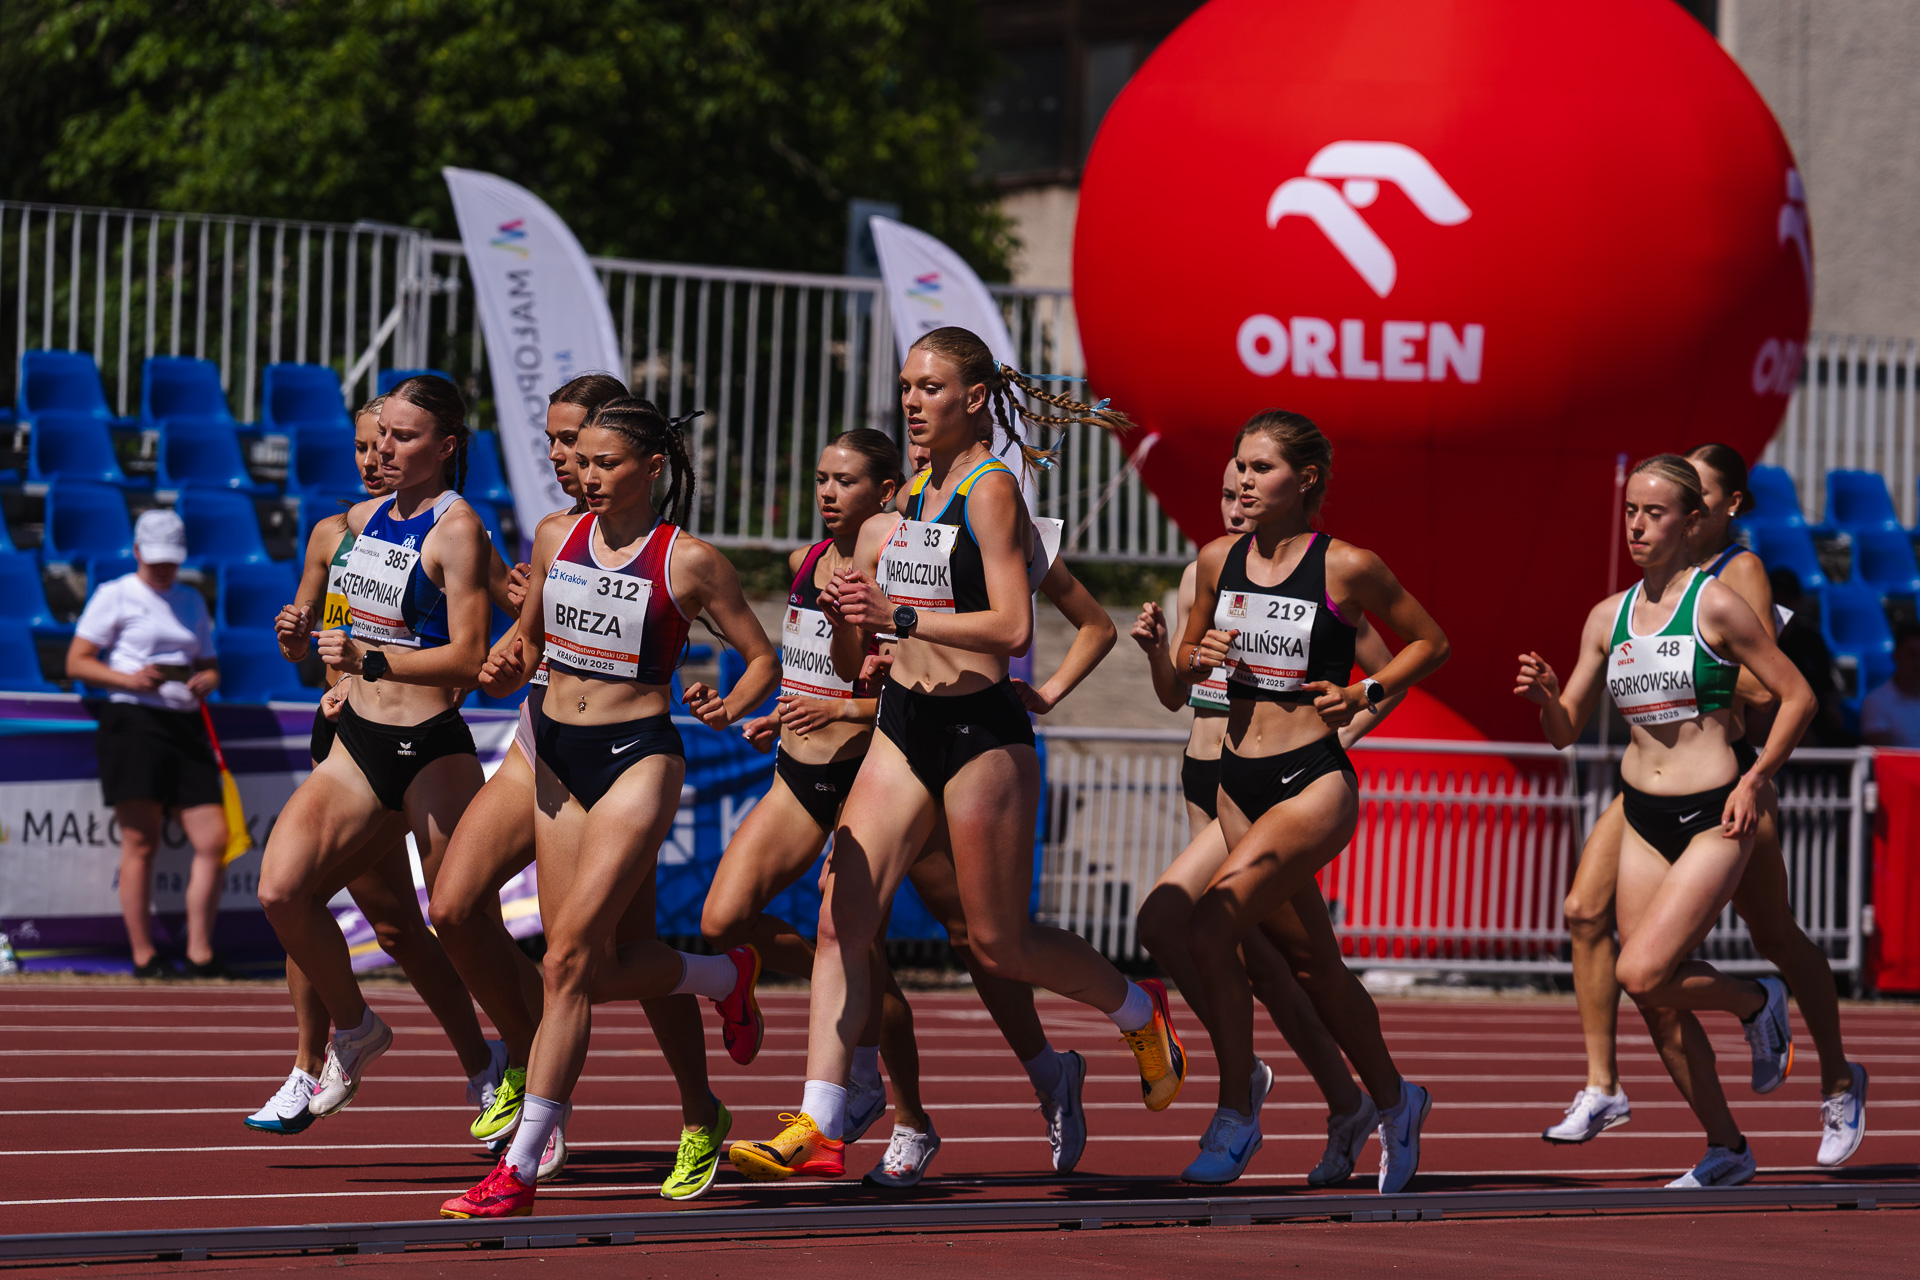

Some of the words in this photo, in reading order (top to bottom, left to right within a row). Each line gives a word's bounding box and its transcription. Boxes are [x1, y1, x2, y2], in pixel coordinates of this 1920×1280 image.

[1236, 313, 1485, 384] ORLEN
[924, 528, 942, 548] 33
[384, 548, 410, 571] 385
[559, 571, 588, 587] Kraków
[596, 576, 640, 602] 312
[343, 571, 403, 609] STEMPNIAK
[555, 602, 622, 639] BREZA
[1266, 600, 1307, 622] 219
[372, 625, 391, 637] 2025
[596, 648, 615, 659] Polski
[615, 652, 630, 661] U23
[1656, 641, 1681, 657] 48
[556, 649, 588, 666] KRAKÓW
[589, 659, 615, 671] 2025
[1617, 657, 1635, 667] ORLEN
[1265, 678, 1286, 688] 2025
[1610, 670, 1692, 698] BORKOWSKA
[1197, 688, 1227, 701] KRAKÓW
[1632, 713, 1657, 723] KRAKÓW
[1658, 710, 1680, 720] 2025
